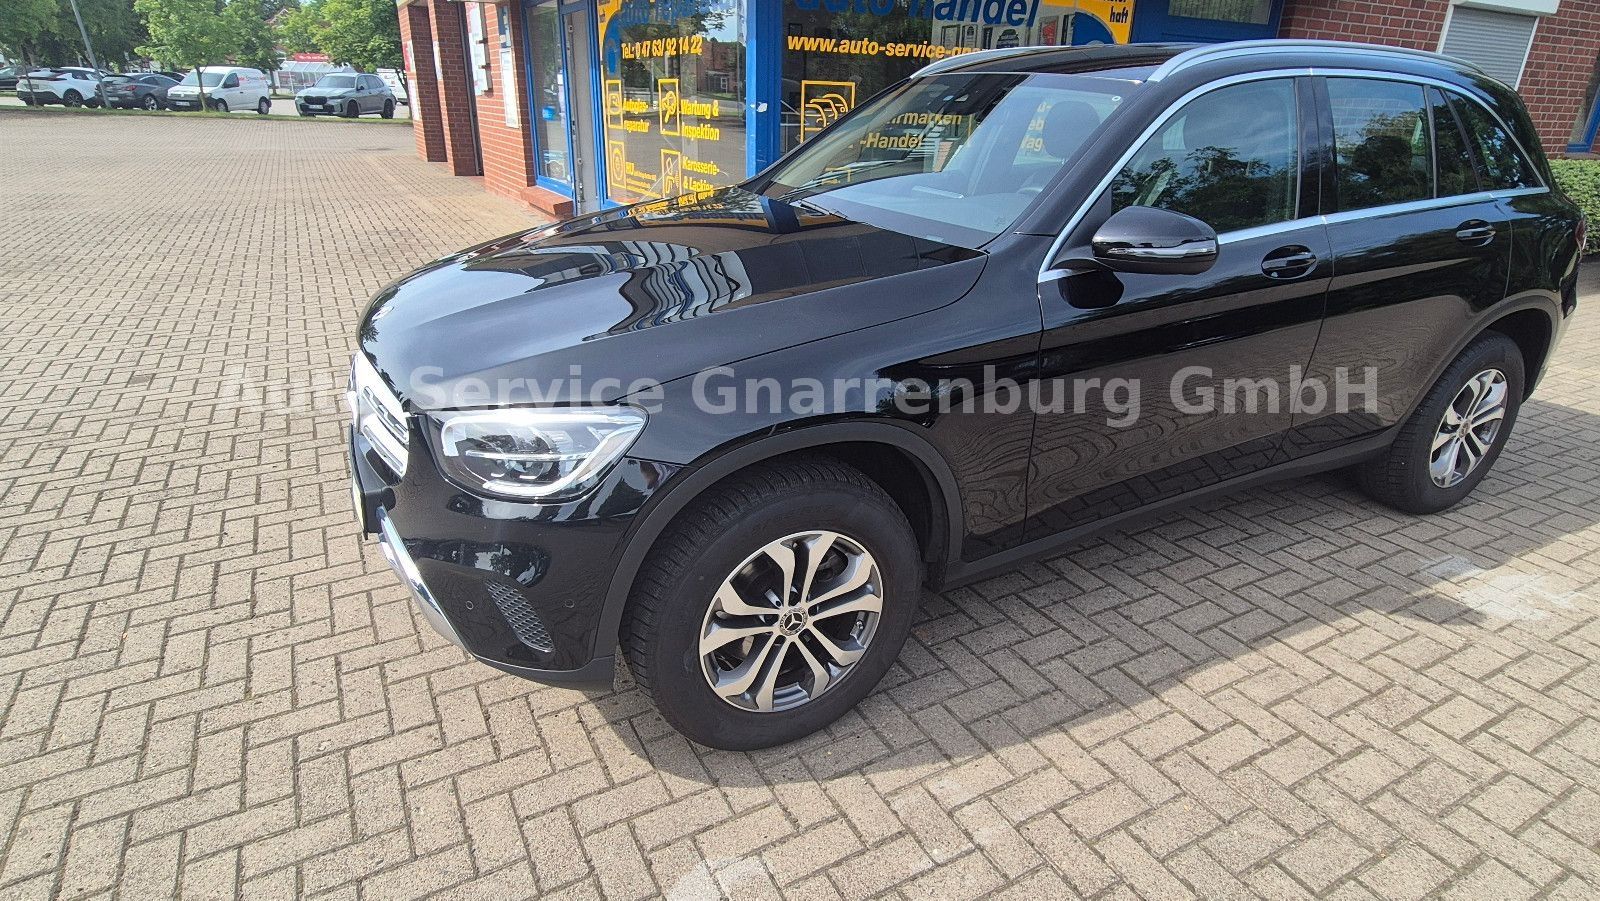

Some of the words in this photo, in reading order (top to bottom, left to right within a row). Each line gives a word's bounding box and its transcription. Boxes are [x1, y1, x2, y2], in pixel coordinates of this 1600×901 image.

[642, 40, 651, 57] 47
[666, 37, 676, 56] 92
[679, 36, 689, 54] 14
[690, 34, 703, 55] 22
[680, 99, 711, 119] Wartung
[712, 99, 719, 117] &
[682, 121, 720, 141] Inspektion
[682, 156, 720, 176] Karosserie-
